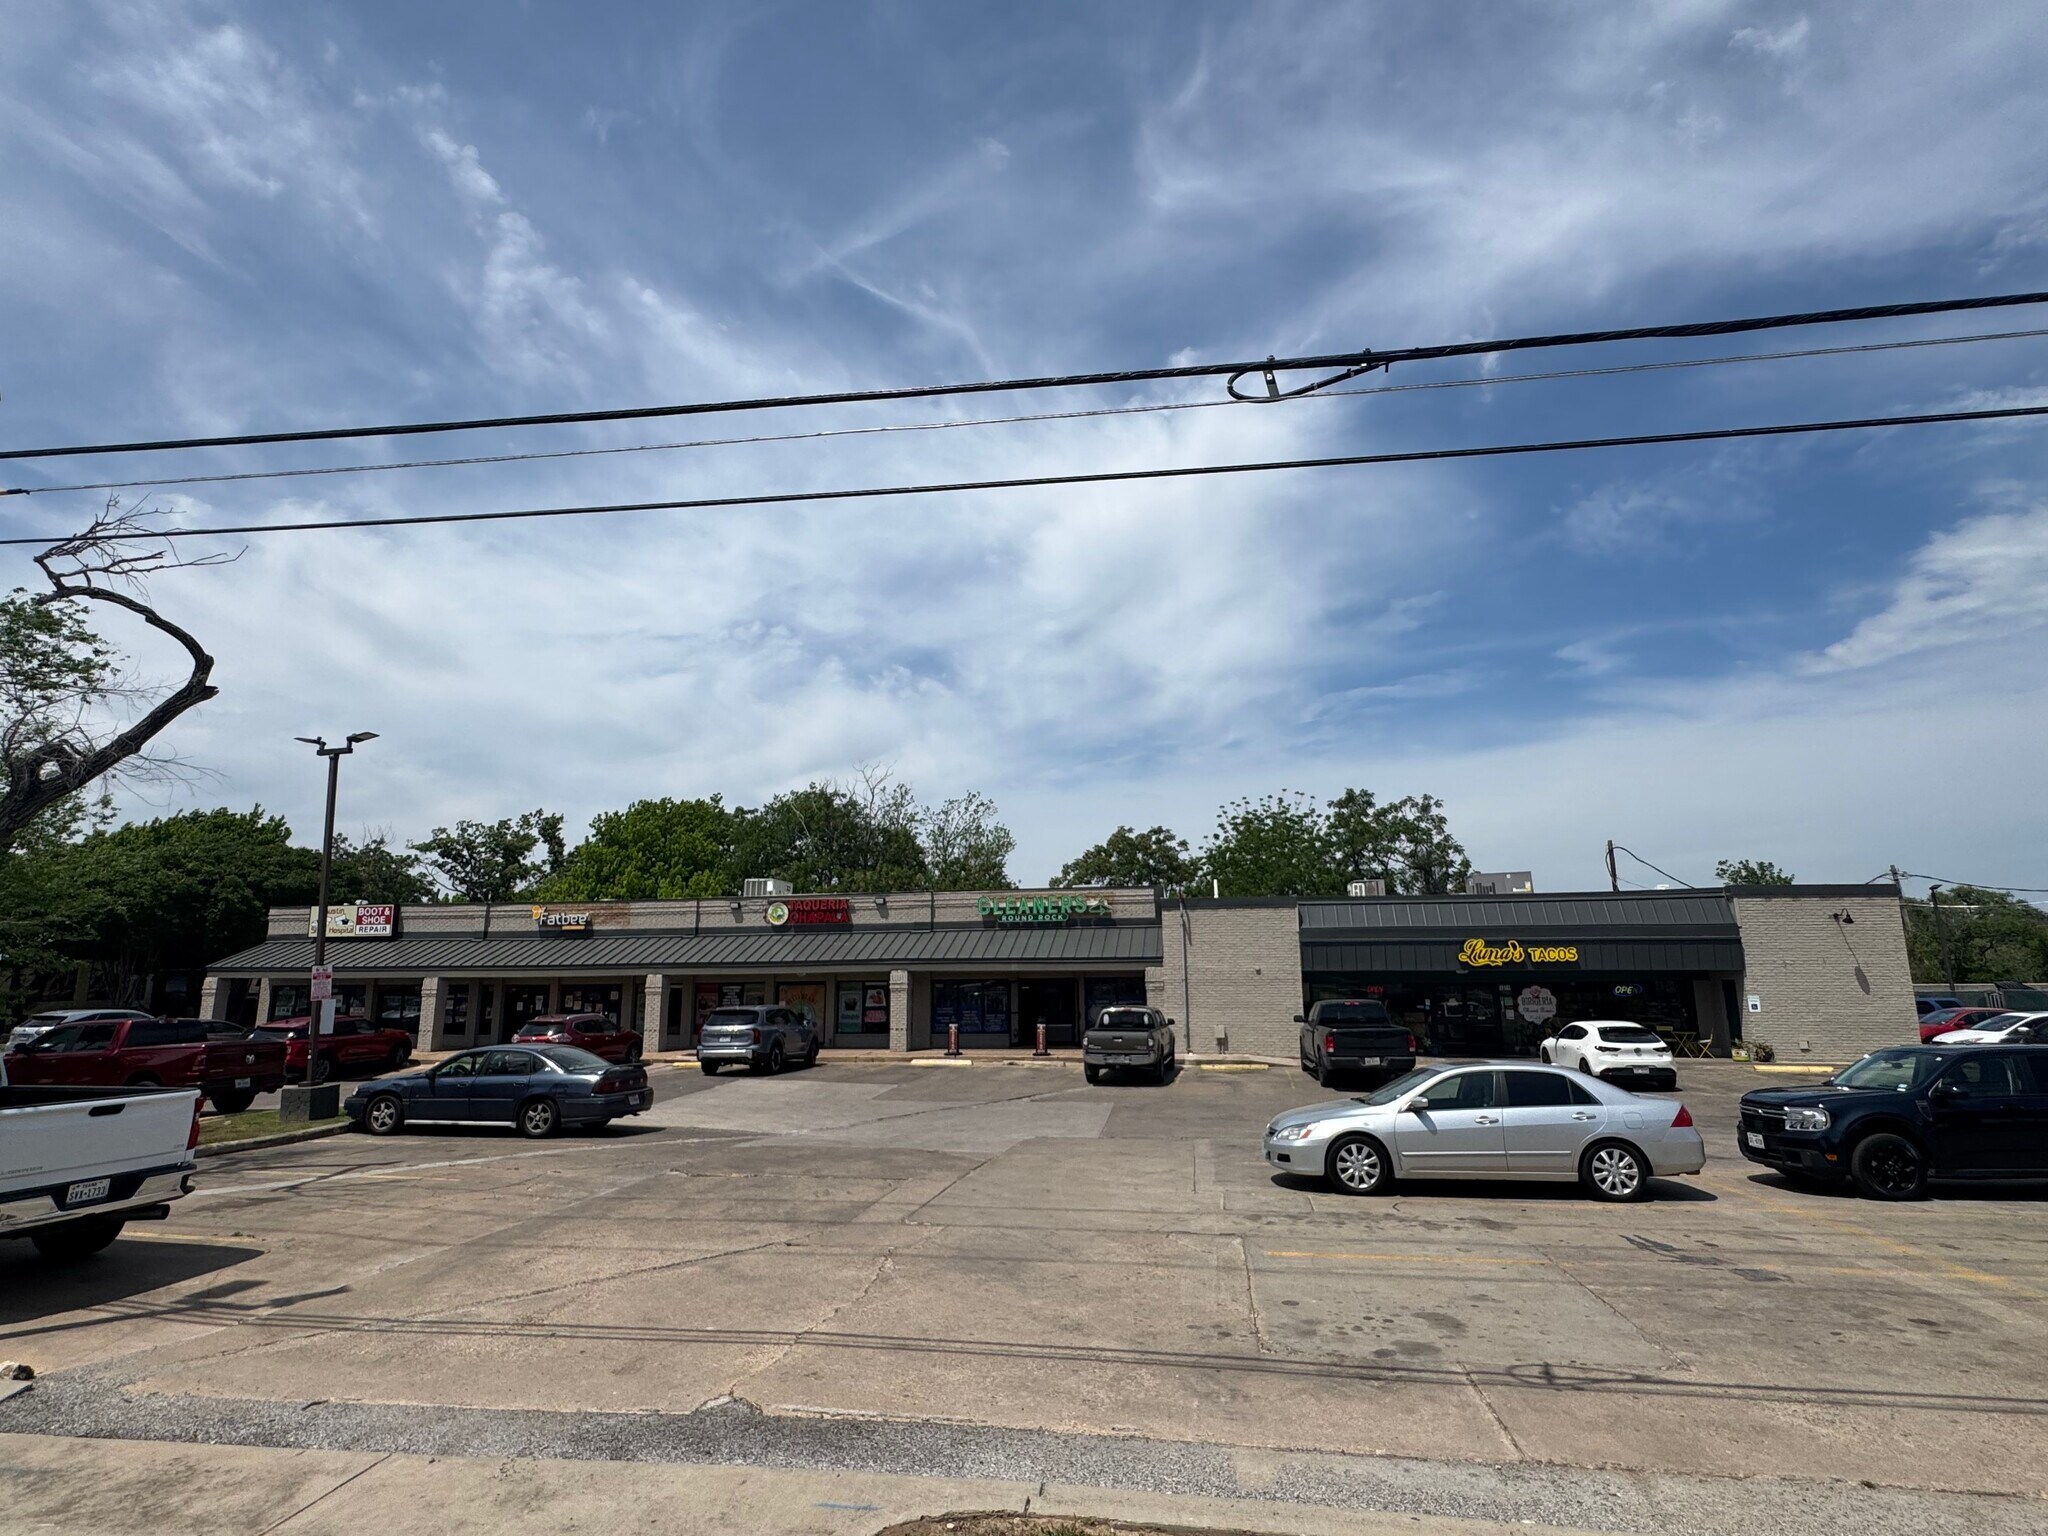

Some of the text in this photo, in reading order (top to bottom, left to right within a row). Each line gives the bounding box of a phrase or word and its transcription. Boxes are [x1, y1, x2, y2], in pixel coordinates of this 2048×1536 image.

[788, 898, 848, 910] TAQUERIA
[977, 895, 1087, 914] CLEANERS
[358, 907, 383, 915] BOOT
[789, 911, 848, 923] CHAPALA
[362, 916, 386, 924] SHOE
[540, 912, 589, 925] Fatbee
[328, 927, 354, 935] Hospital
[1458, 939, 1578, 966] Luna's TACOS
